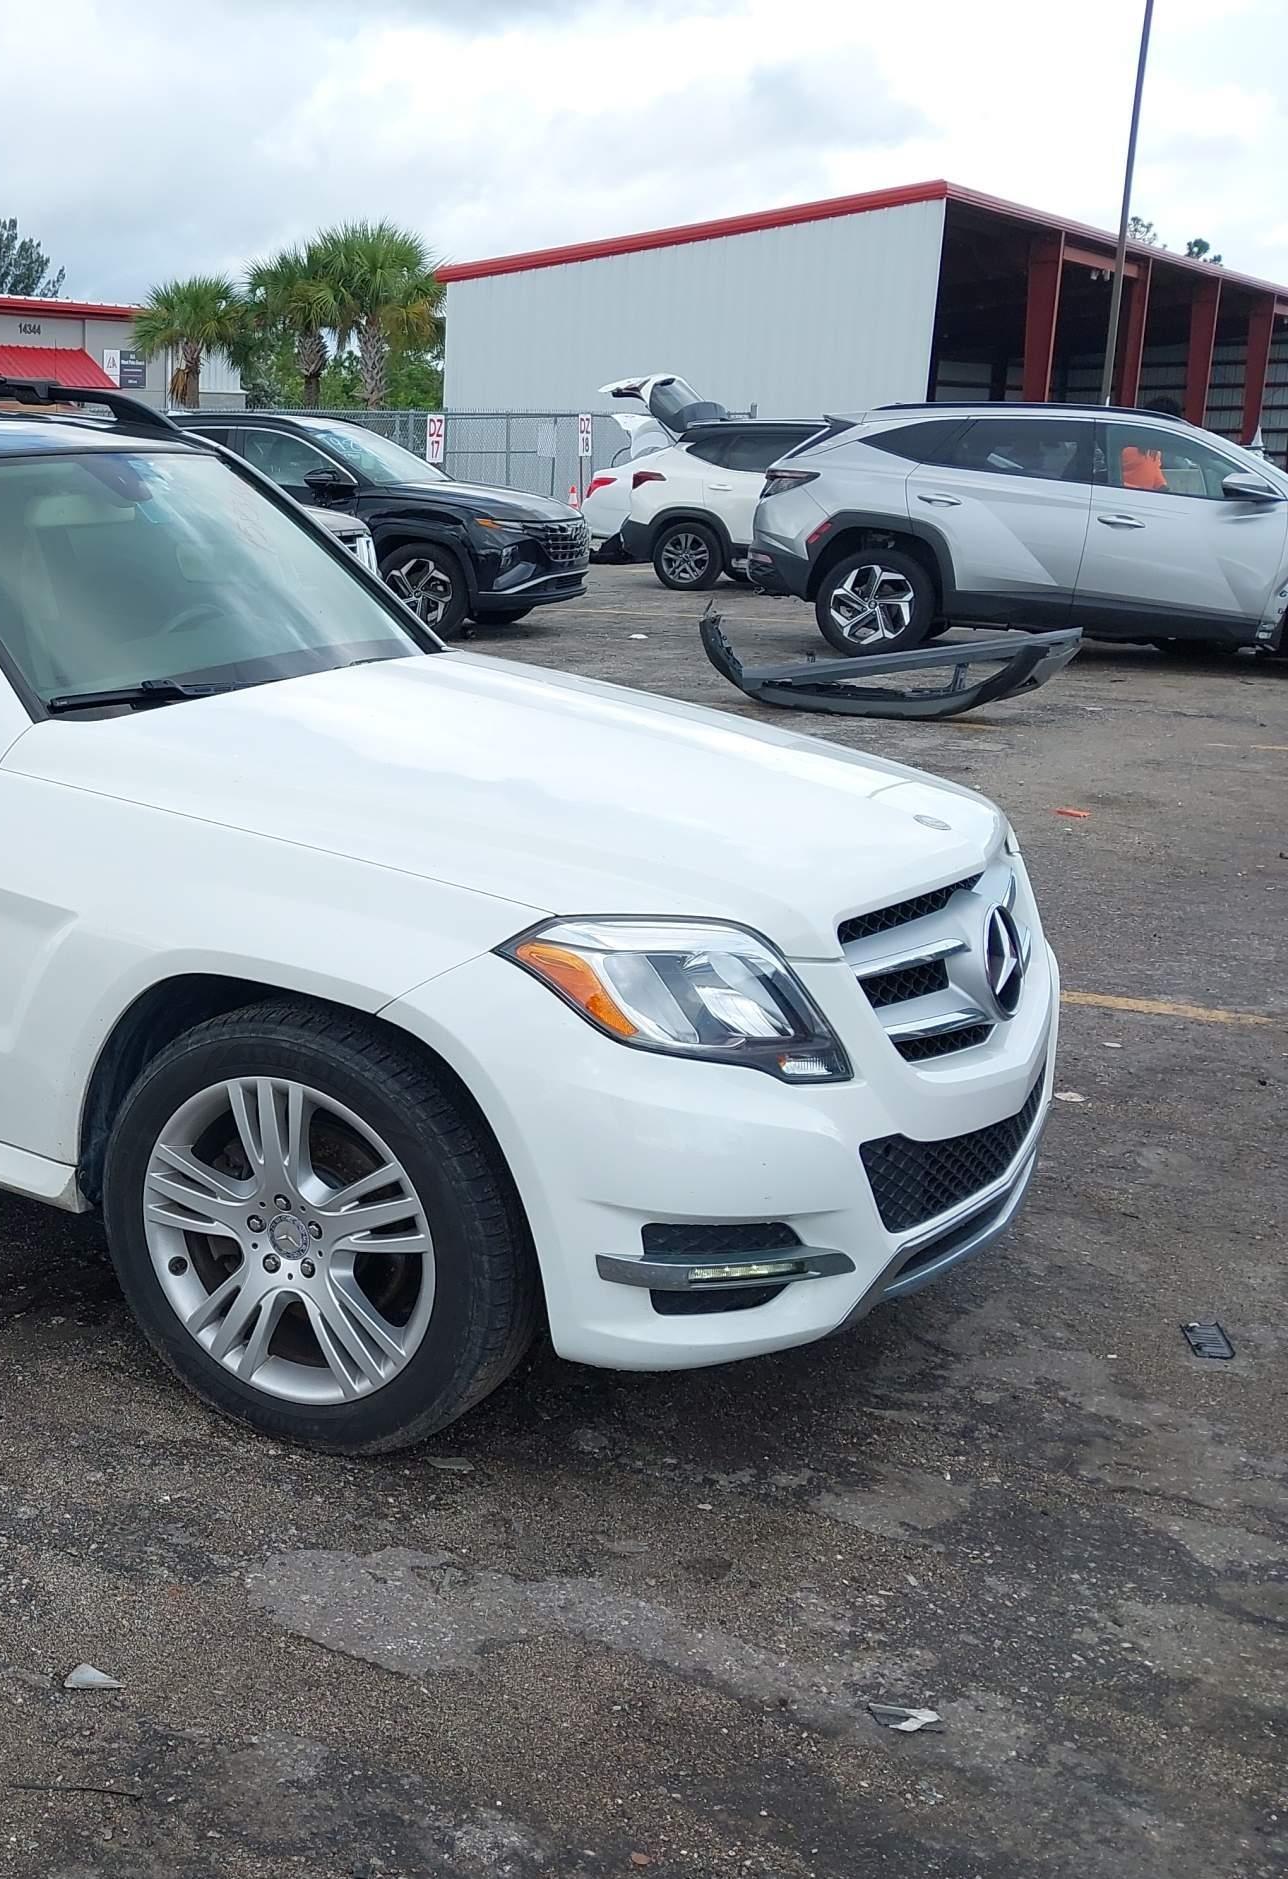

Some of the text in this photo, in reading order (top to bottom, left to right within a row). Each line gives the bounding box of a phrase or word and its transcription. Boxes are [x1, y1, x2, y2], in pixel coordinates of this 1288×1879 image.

[19, 323, 41, 335] 14344
[429, 418, 443, 437] DZ
[580, 417, 591, 434] DZ
[431, 440, 440, 459] 17
[582, 436, 590, 453] 18
